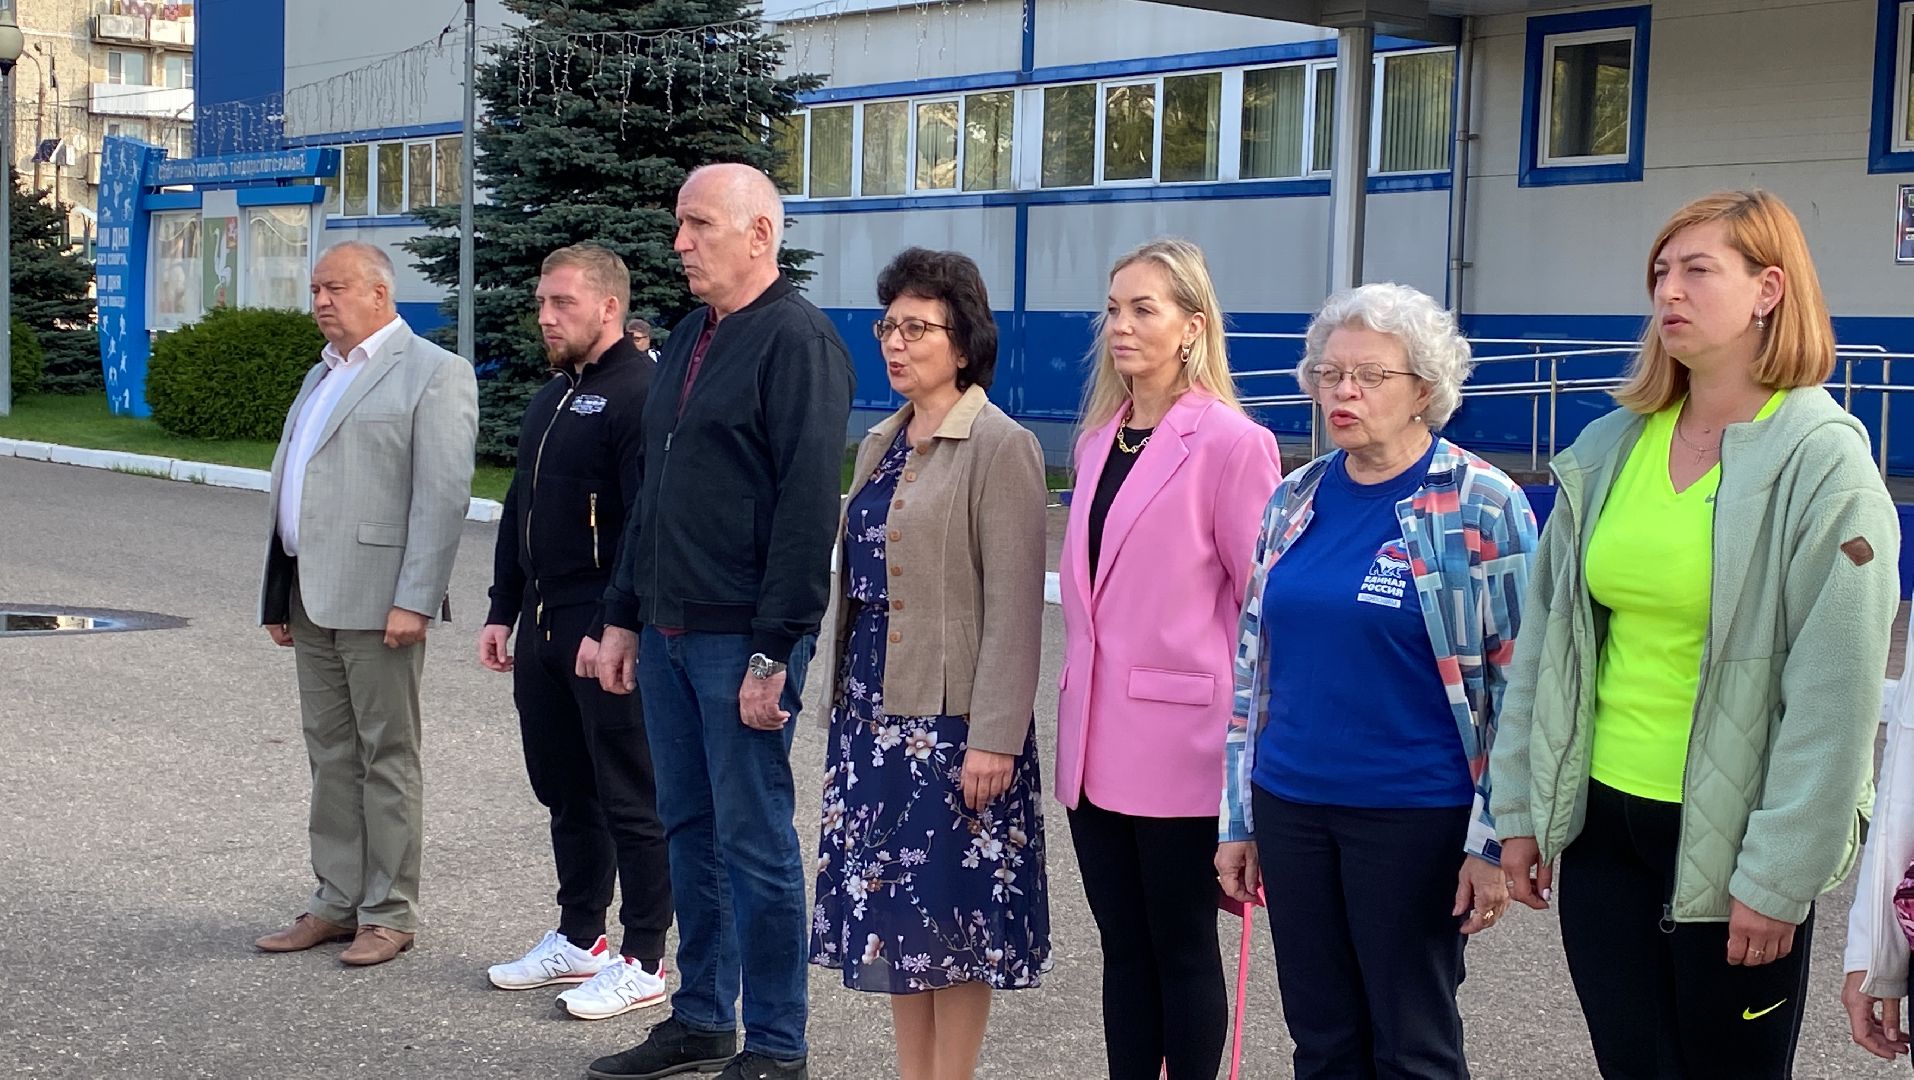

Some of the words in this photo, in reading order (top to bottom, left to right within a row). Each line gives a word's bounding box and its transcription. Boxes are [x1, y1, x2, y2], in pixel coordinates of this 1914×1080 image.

[98, 228, 110, 248] НИ
[112, 228, 129, 250] ДНЯ
[1364, 576, 1406, 588] ЕДИНАЯ
[1361, 583, 1403, 597] РОССИЯ
